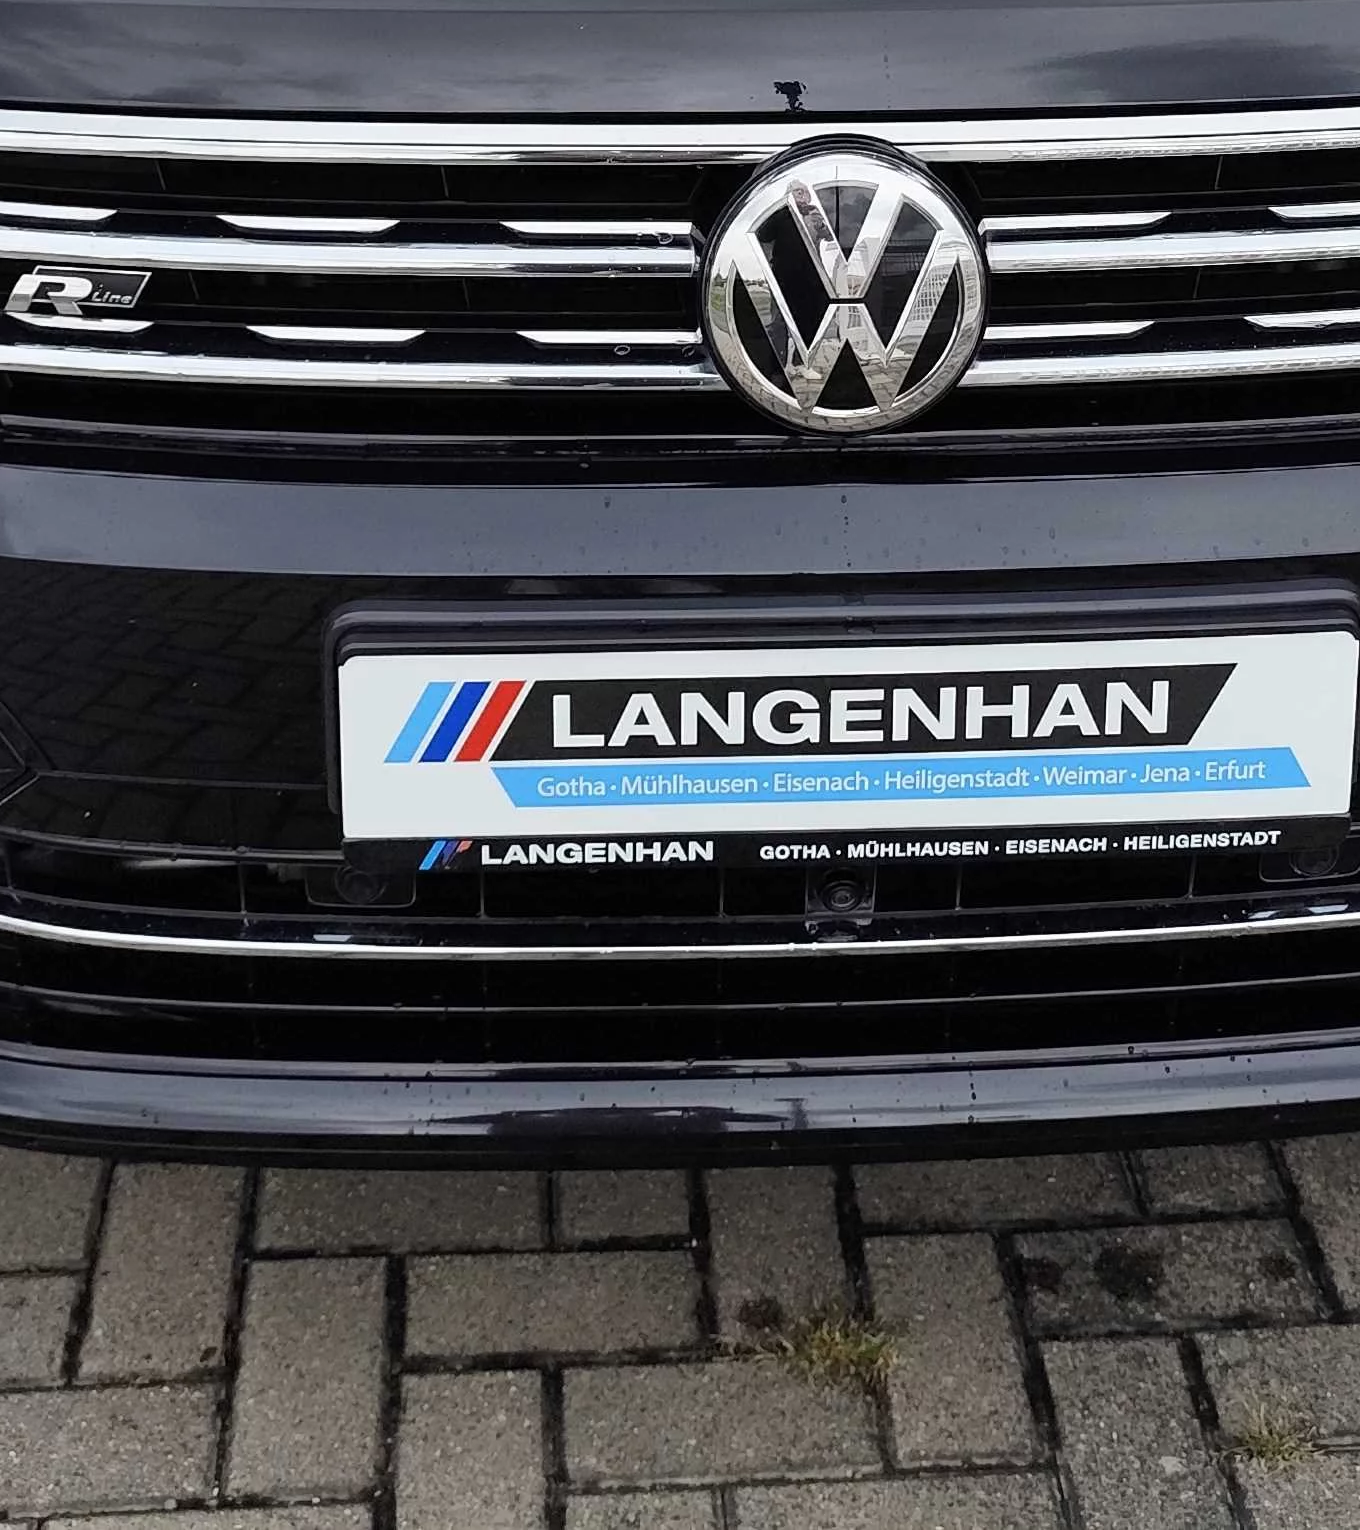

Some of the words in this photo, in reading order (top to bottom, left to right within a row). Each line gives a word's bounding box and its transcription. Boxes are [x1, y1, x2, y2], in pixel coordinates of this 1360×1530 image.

[552, 679, 1170, 748] LANGENHAN
[537, 775, 607, 798] Gotha
[621, 772, 758, 797] Mühlhausen
[772, 769, 870, 793] Eisenach
[884, 765, 1030, 794] Heiligenstadt
[1043, 764, 1128, 787] Weimar
[1140, 762, 1191, 784] Jena
[1204, 759, 1267, 782] Erfurt
[480, 839, 715, 866] LANGENHAN
[759, 844, 831, 861] GOTHA
[846, 838, 990, 859] MÜHLHAUSEN
[1005, 836, 1108, 856] EISENACH
[1123, 830, 1282, 851] HEILIGENSTADT
